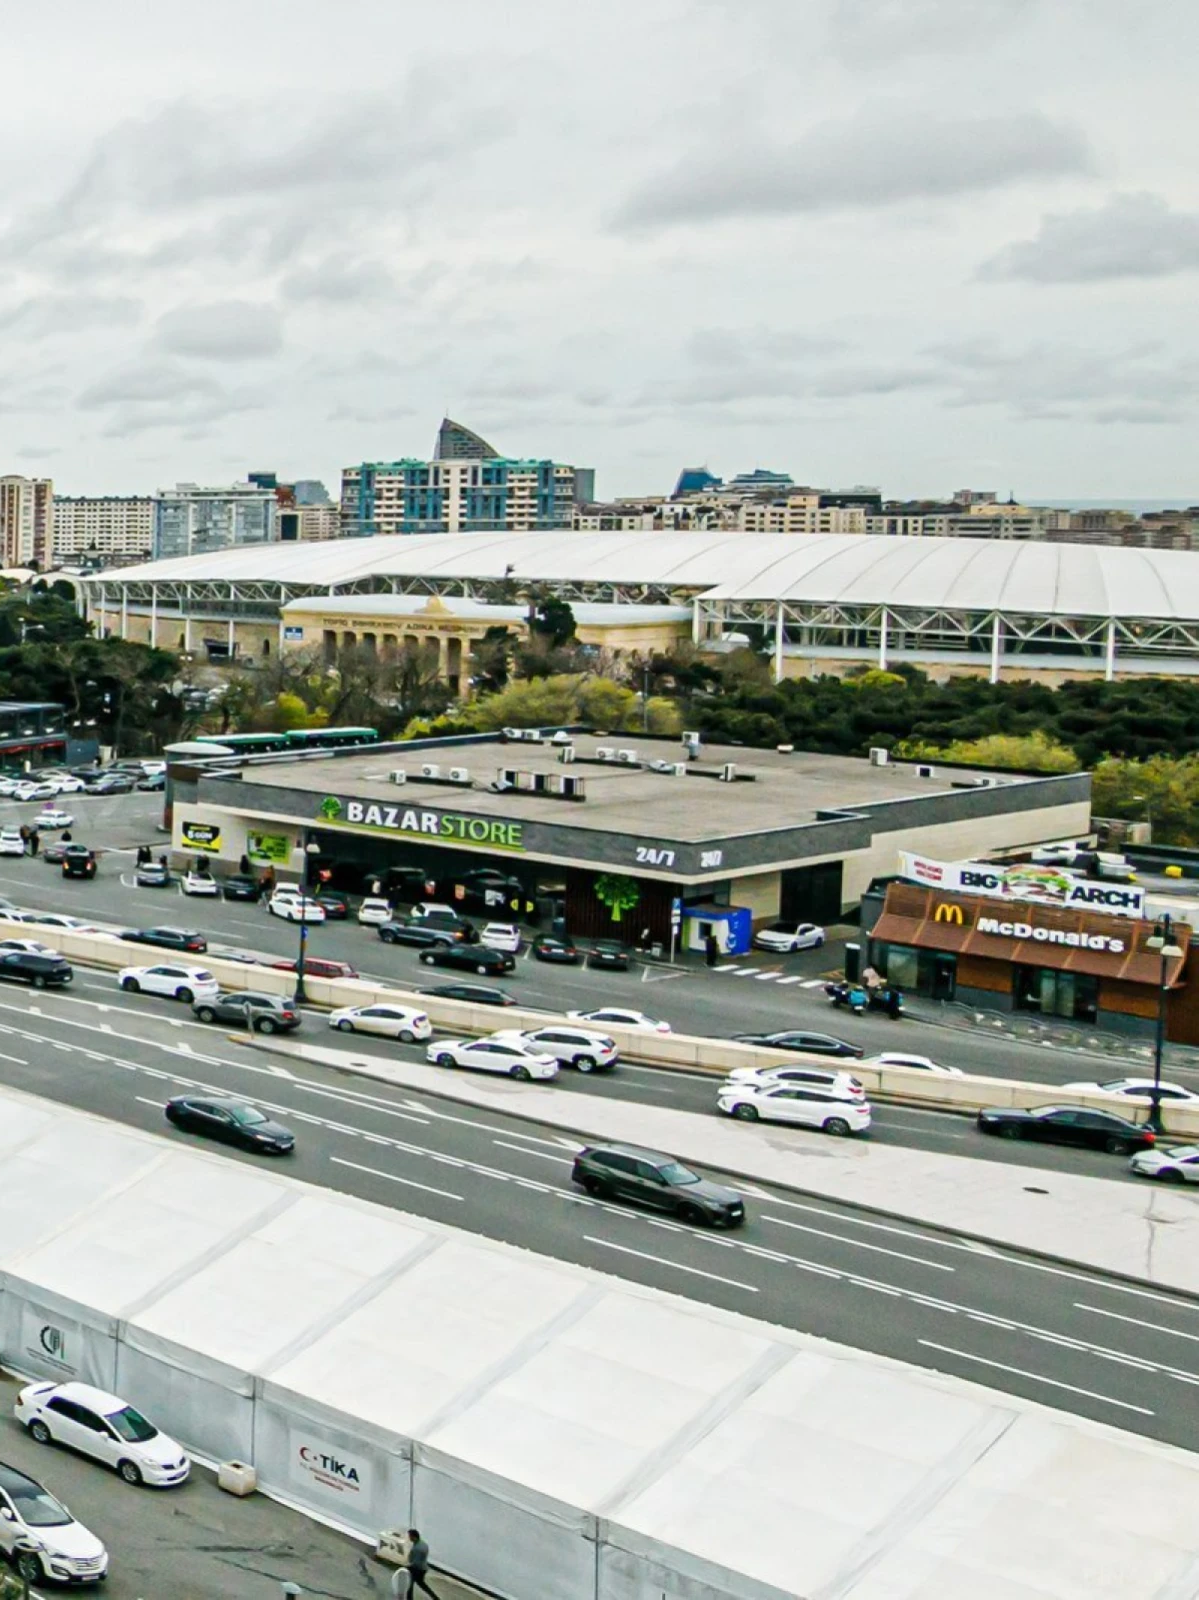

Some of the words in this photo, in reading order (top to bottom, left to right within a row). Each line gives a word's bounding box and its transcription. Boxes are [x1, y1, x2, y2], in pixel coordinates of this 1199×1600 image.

[347, 801, 522, 846] BAZARSTORE
[636, 847, 675, 866] 24/7
[960, 871, 998, 889] BIG
[1070, 886, 1141, 909] ARCH
[976, 917, 1124, 953] McDonald's
